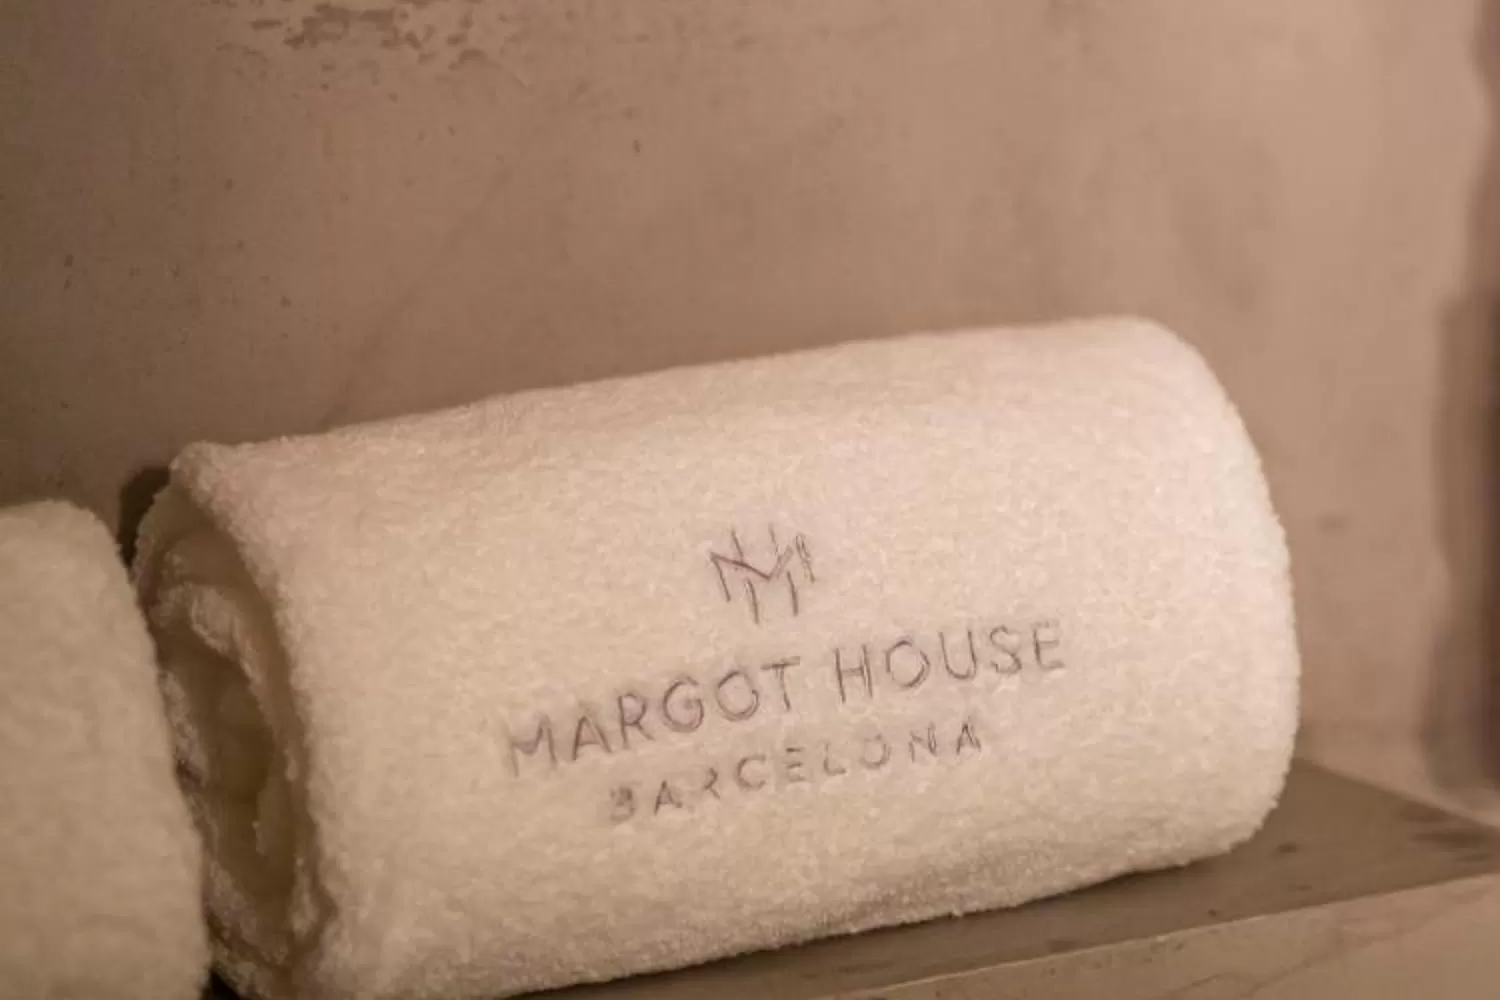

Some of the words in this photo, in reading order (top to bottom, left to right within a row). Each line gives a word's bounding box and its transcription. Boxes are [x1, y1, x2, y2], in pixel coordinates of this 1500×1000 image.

[507, 658, 800, 776] MARGOT
[834, 622, 1067, 702] HOUSE
[609, 716, 982, 821] BARCELONA
